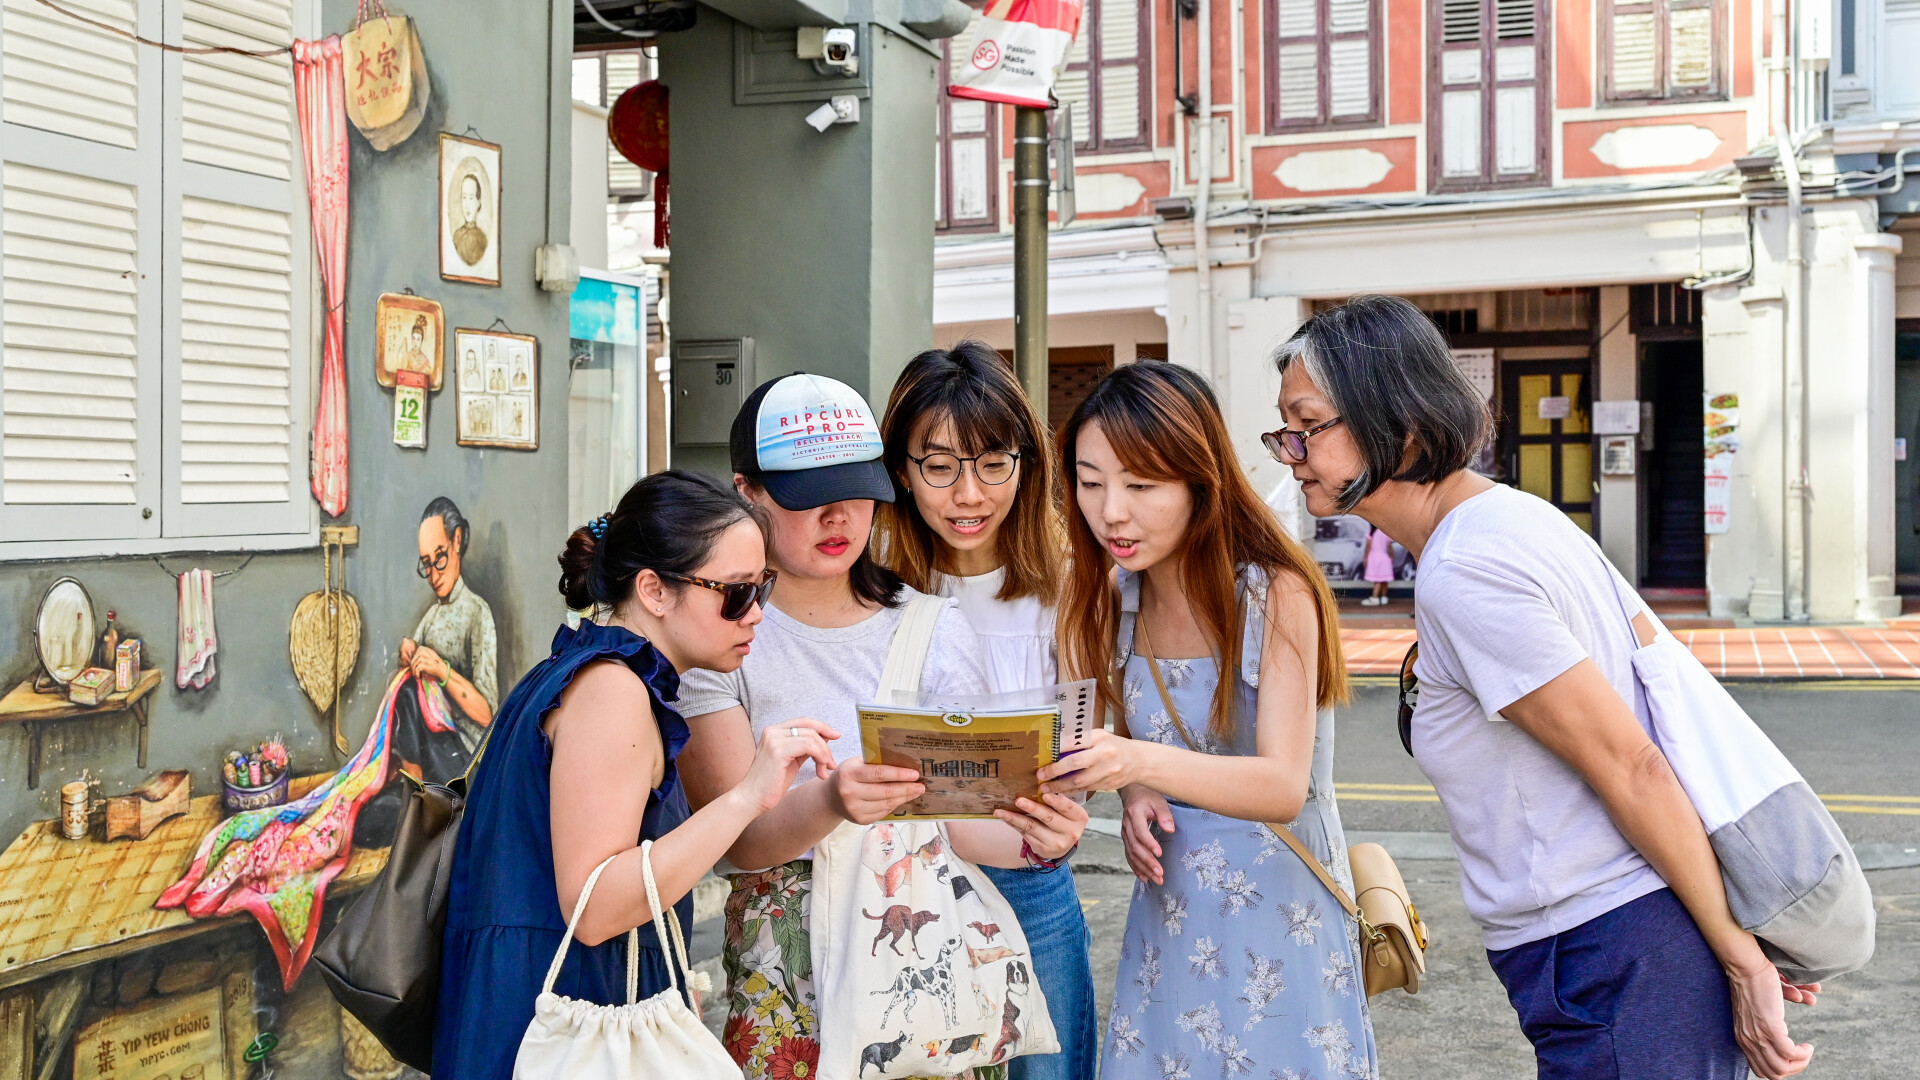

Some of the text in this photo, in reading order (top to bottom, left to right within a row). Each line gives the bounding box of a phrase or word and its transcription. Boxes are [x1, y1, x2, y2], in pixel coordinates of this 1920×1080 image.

[976, 47, 996, 62] SG
[1006, 45, 1036, 55] Passion
[356, 41, 400, 90] 大宗
[1004, 55, 1025, 64] Made
[1001, 64, 1035, 77] Possible
[716, 369, 733, 386] 30
[400, 397, 420, 420] 12
[806, 421, 846, 435] PRO
[797, 438, 825, 446] BELLS
[792, 446, 825, 456] VICTORIA
[228, 977, 247, 1009] 2019
[122, 1015, 211, 1055] YIP YEW CHONG
[93, 1039, 117, 1080] 葉
[139, 1041, 192, 1068] YIPYC.COM
